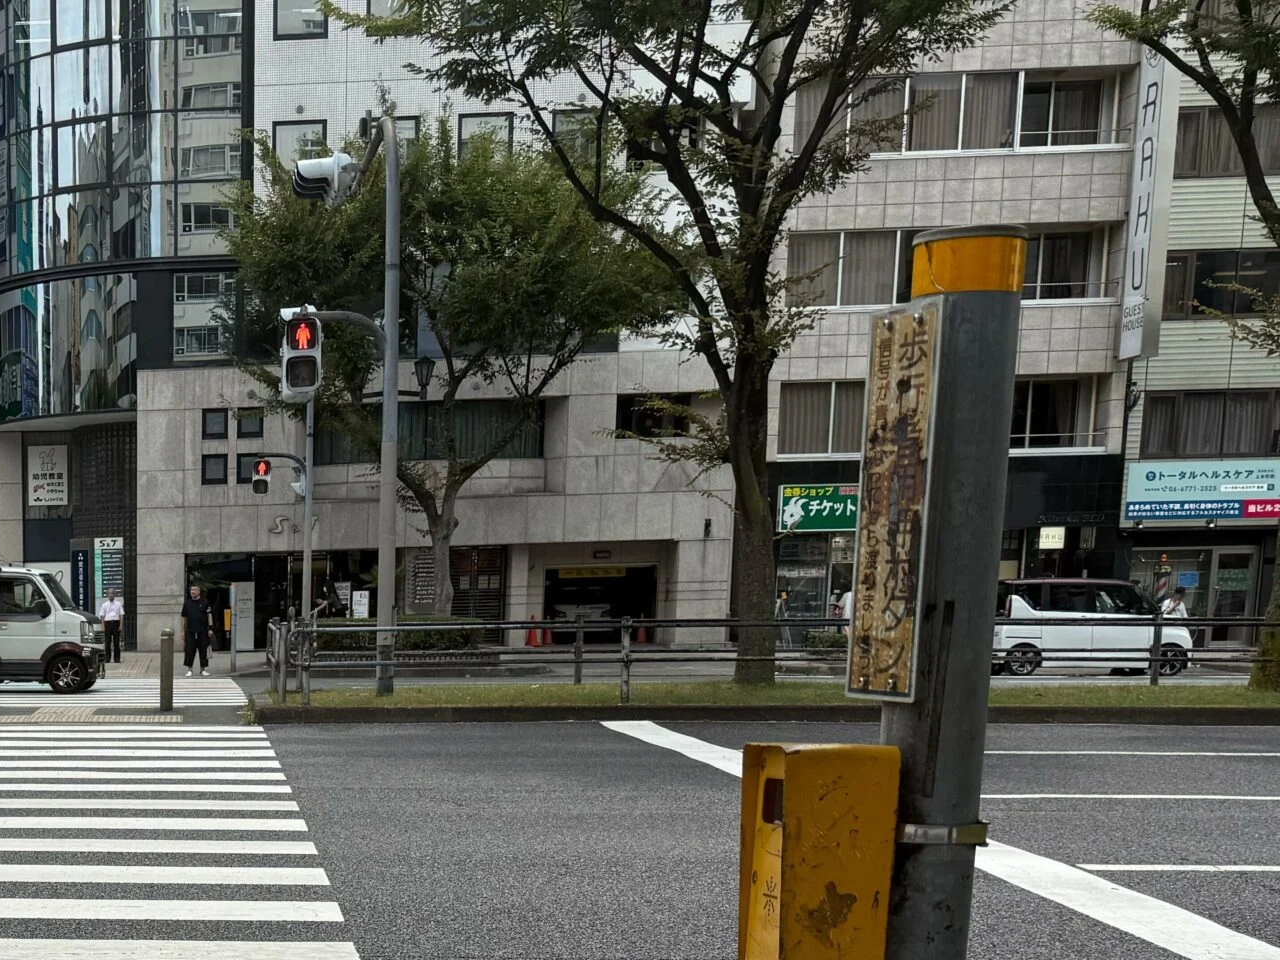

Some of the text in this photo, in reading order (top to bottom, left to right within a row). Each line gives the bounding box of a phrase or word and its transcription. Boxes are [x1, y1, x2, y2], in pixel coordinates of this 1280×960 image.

[1131, 81, 1159, 291] RAKU
[1122, 315, 1144, 334] HOUSE
[32, 472, 64, 480] 幼児教室
[1158, 469, 1255, 481] トータルヘルスケア
